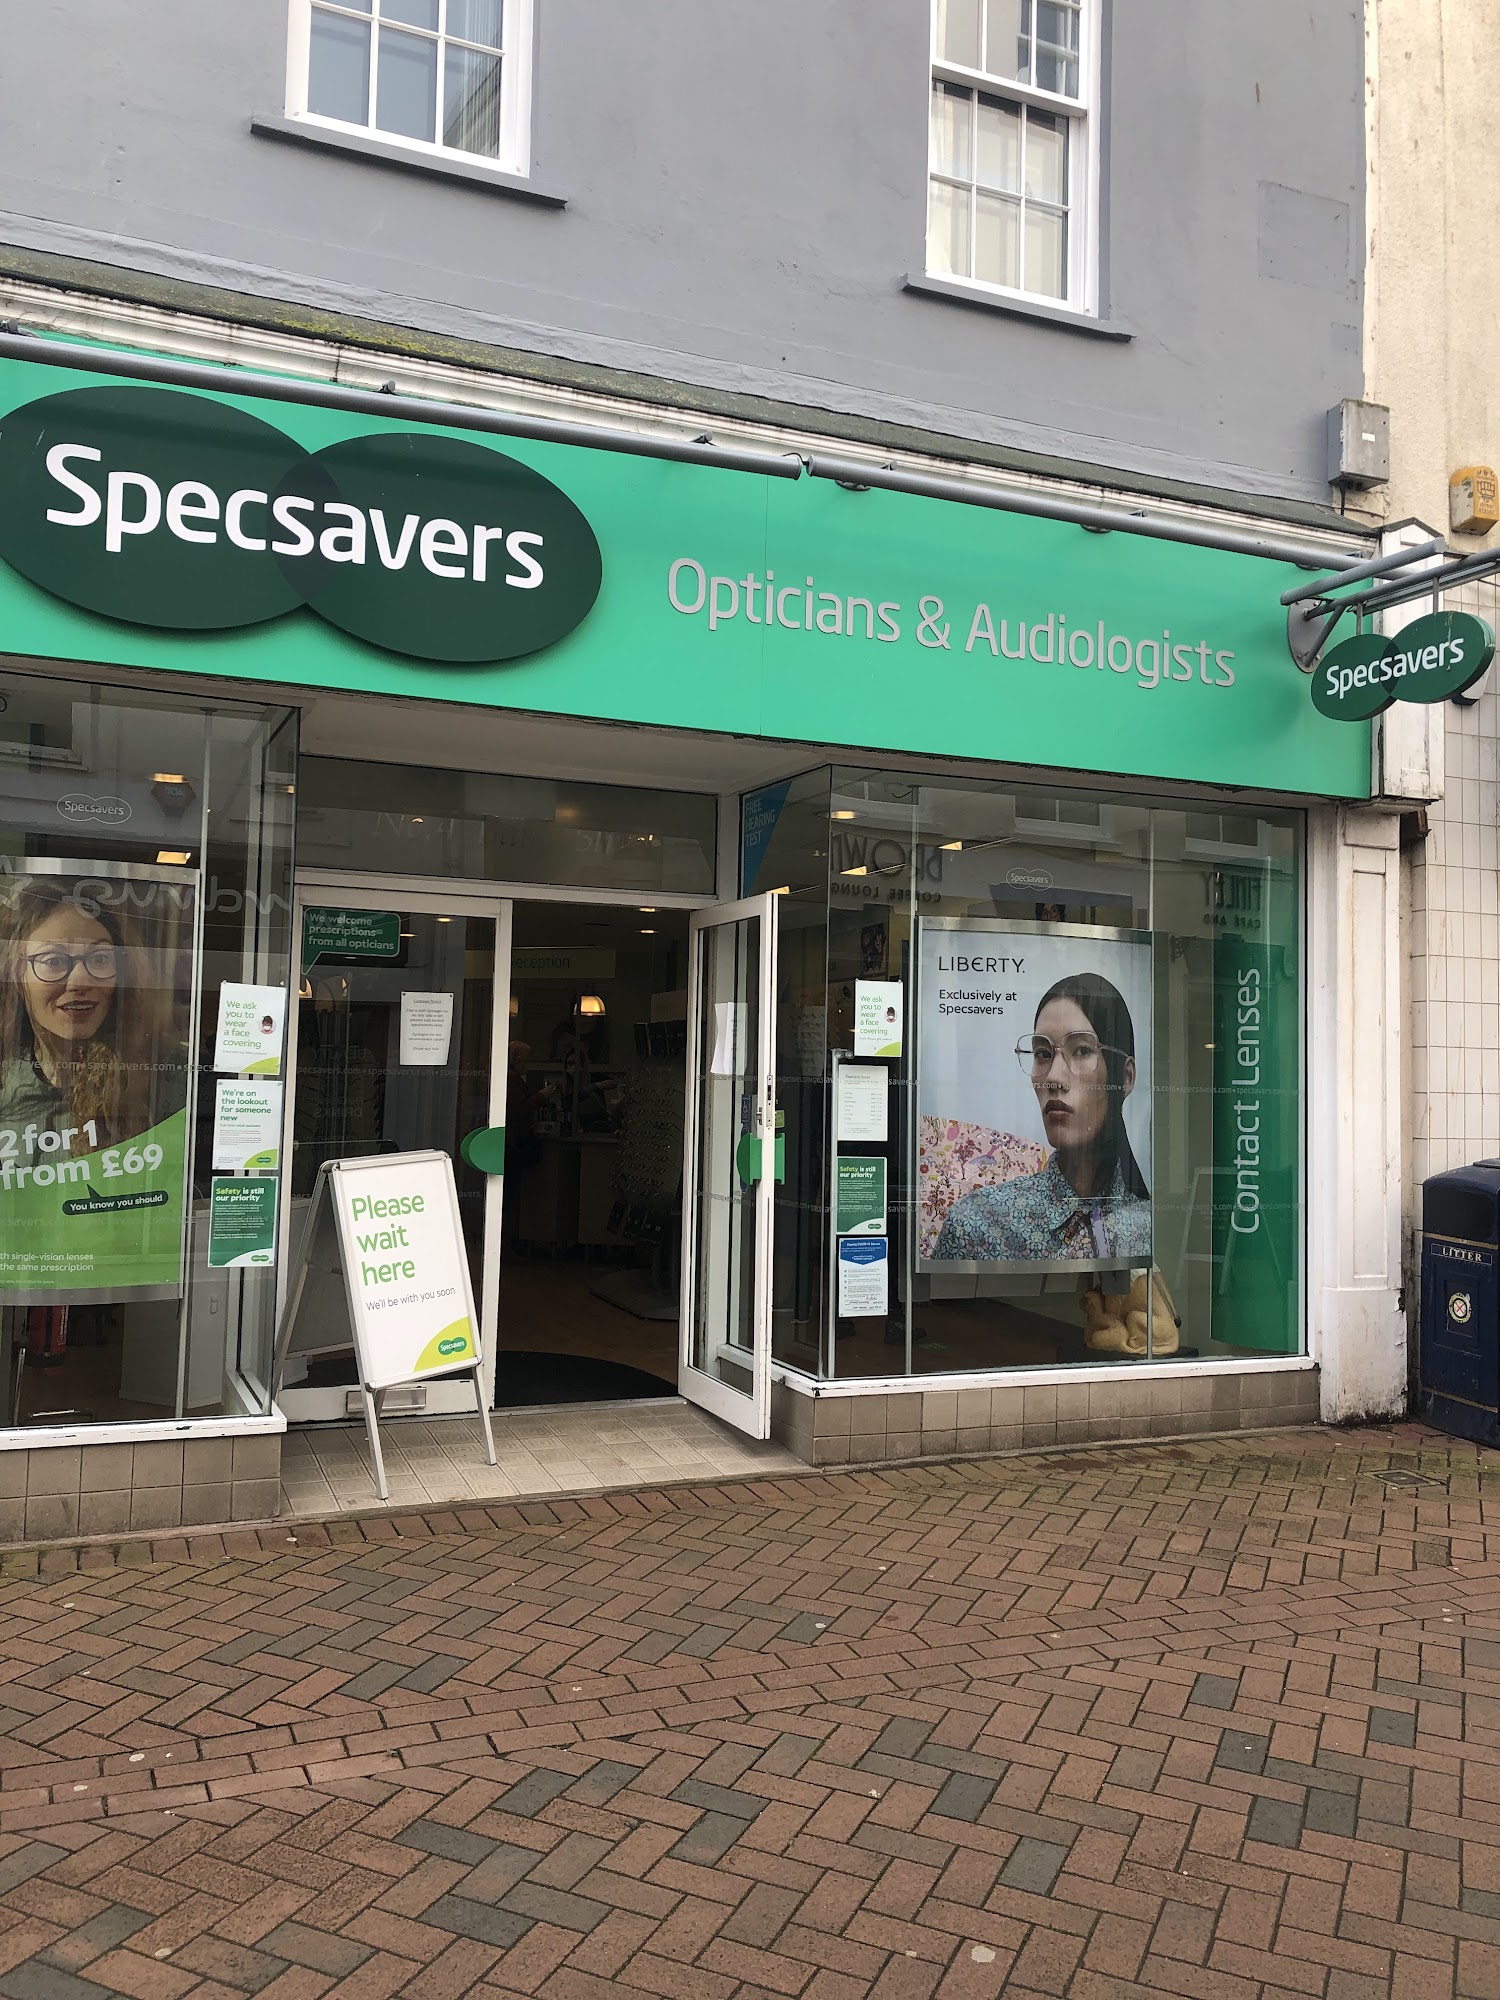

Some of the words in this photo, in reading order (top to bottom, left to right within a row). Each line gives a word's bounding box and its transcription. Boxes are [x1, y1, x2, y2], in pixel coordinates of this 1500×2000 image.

[45, 443, 545, 590] Specsavers
[667, 557, 901, 643] Opticians
[917, 595, 951, 650] &
[966, 603, 1236, 689] Audiologists
[1326, 637, 1465, 700] Specsavers
[64, 800, 125, 815] Specsavers
[745, 798, 762, 816] FREE
[745, 808, 776, 833] HEARING
[744, 829, 763, 848] TEST
[1010, 872, 1049, 884] Specsavers
[309, 912, 326, 923] We
[328, 914, 373, 926] welcome
[308, 926, 377, 937] prescriptions
[308, 936, 334, 946] from
[335, 938, 347, 947] all
[348, 939, 395, 950] opticians
[860, 995, 871, 1003] We
[871, 995, 883, 1003] ask
[939, 989, 1002, 1004] Exclusively
[1005, 991, 1018, 1002] at
[226, 1000, 241, 1009] We
[242, 1001, 258, 1010] ask
[860, 1003, 873, 1011] you
[938, 1003, 1004, 1016] Specsavers
[225, 1011, 243, 1019] you
[244, 1011, 255, 1019] to
[224, 1020, 248, 1028] wear
[865, 1018, 880, 1026] face
[1231, 968, 1261, 1086] Lenses
[231, 1028, 251, 1038] face
[859, 1026, 888, 1036] covering
[222, 1039, 262, 1050] covering
[221, 1089, 244, 1097] We're
[221, 1097, 236, 1105] the
[237, 1098, 268, 1106] lookout
[220, 1105, 233, 1113] for
[0, 1129, 19, 1158] 2
[22, 1124, 79, 1155] for
[83, 1119, 98, 1147] 1
[0, 1159, 91, 1191] from
[101, 1143, 164, 1178] £69
[1231, 1100, 1261, 1234] Contact
[850, 1171, 874, 1179] priority
[215, 1187, 241, 1196] Safety
[242, 1187, 249, 1195] is
[250, 1187, 265, 1195] still
[69, 1203, 88, 1212] You
[89, 1201, 115, 1210] know
[116, 1199, 134, 1209] you
[134, 1194, 163, 1205] should
[230, 1194, 261, 1203] priority
[351, 1194, 425, 1222] Please
[356, 1223, 409, 1253] wait
[11, 1251, 65, 1263] single-vision
[66, 1252, 94, 1261] lenses
[1441, 1245, 1483, 1263] LITTER
[0, 1263, 15, 1271] the
[16, 1264, 39, 1272] same
[40, 1263, 94, 1273] prescription
[361, 1259, 416, 1286] here
[366, 1298, 387, 1312] We'll
[387, 1296, 399, 1308] be
[400, 1293, 419, 1306] with
[420, 1290, 435, 1304] you
[436, 1286, 456, 1298] soon
[440, 1341, 466, 1352] Specsavers
